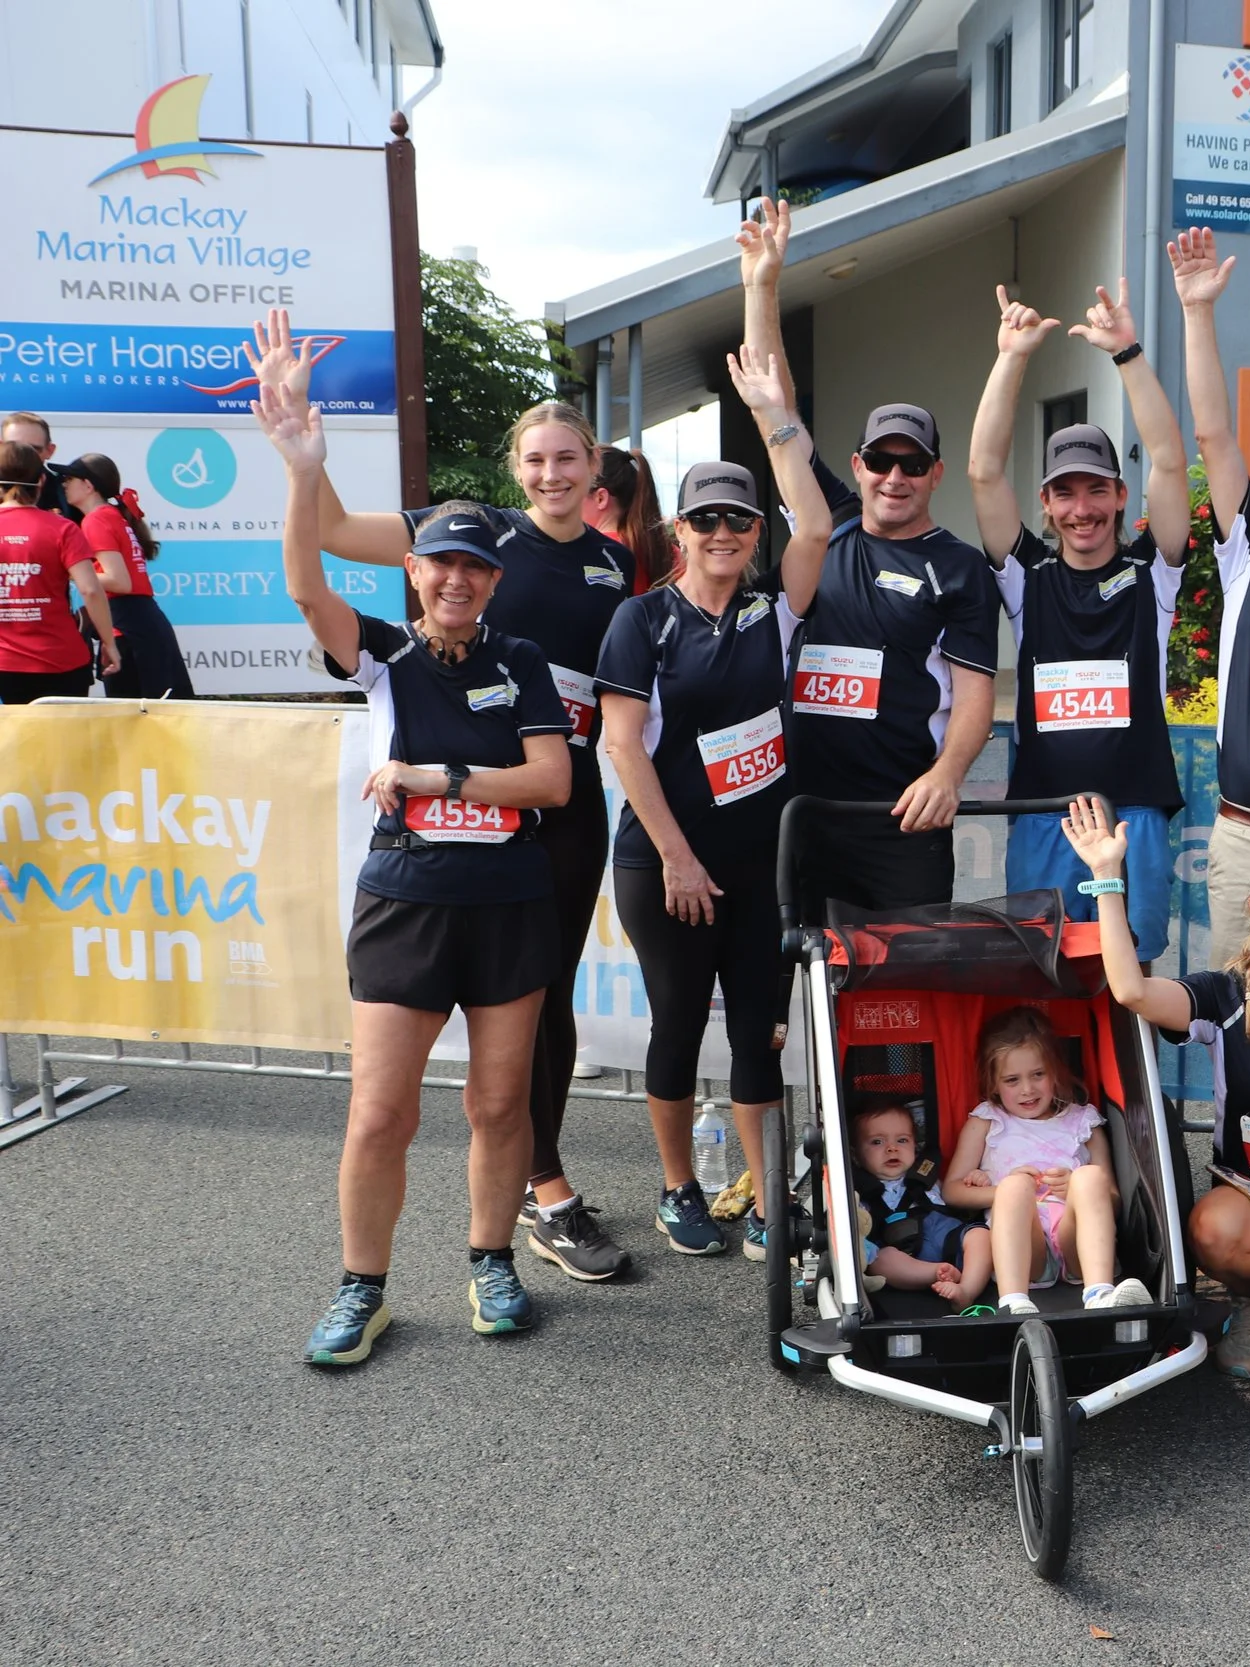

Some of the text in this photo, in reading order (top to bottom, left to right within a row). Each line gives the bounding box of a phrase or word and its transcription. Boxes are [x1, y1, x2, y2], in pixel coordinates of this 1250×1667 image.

[1186, 134, 1238, 151] HAVING
[1208, 154, 1229, 170] We
[1185, 193, 1204, 205] Call
[1206, 195, 1218, 206] 49
[1220, 196, 1238, 207] 554
[99, 194, 247, 234] Mackay
[37, 230, 311, 275] Marina Village
[60, 279, 294, 305] MARINA OFFICE
[0, 333, 97, 367] Peter
[84, 374, 180, 386] BROKERS
[1128, 443, 1140, 464] 4
[150, 521, 221, 531] MARINA
[149, 571, 276, 597] OPERTY
[183, 649, 302, 669] HANDLERY
[803, 675, 864, 704] 4549
[1048, 690, 1115, 718] 4544
[704, 733, 737, 749] mackay
[744, 727, 764, 739] ISUZU
[717, 749, 732, 759] run
[726, 742, 777, 785] 4556
[733, 783, 760, 797] Corporate
[424, 799, 503, 829] 4554
[429, 831, 499, 840] Corporate Challenge
[72, 926, 203, 983] run
[228, 940, 267, 962] BMA
